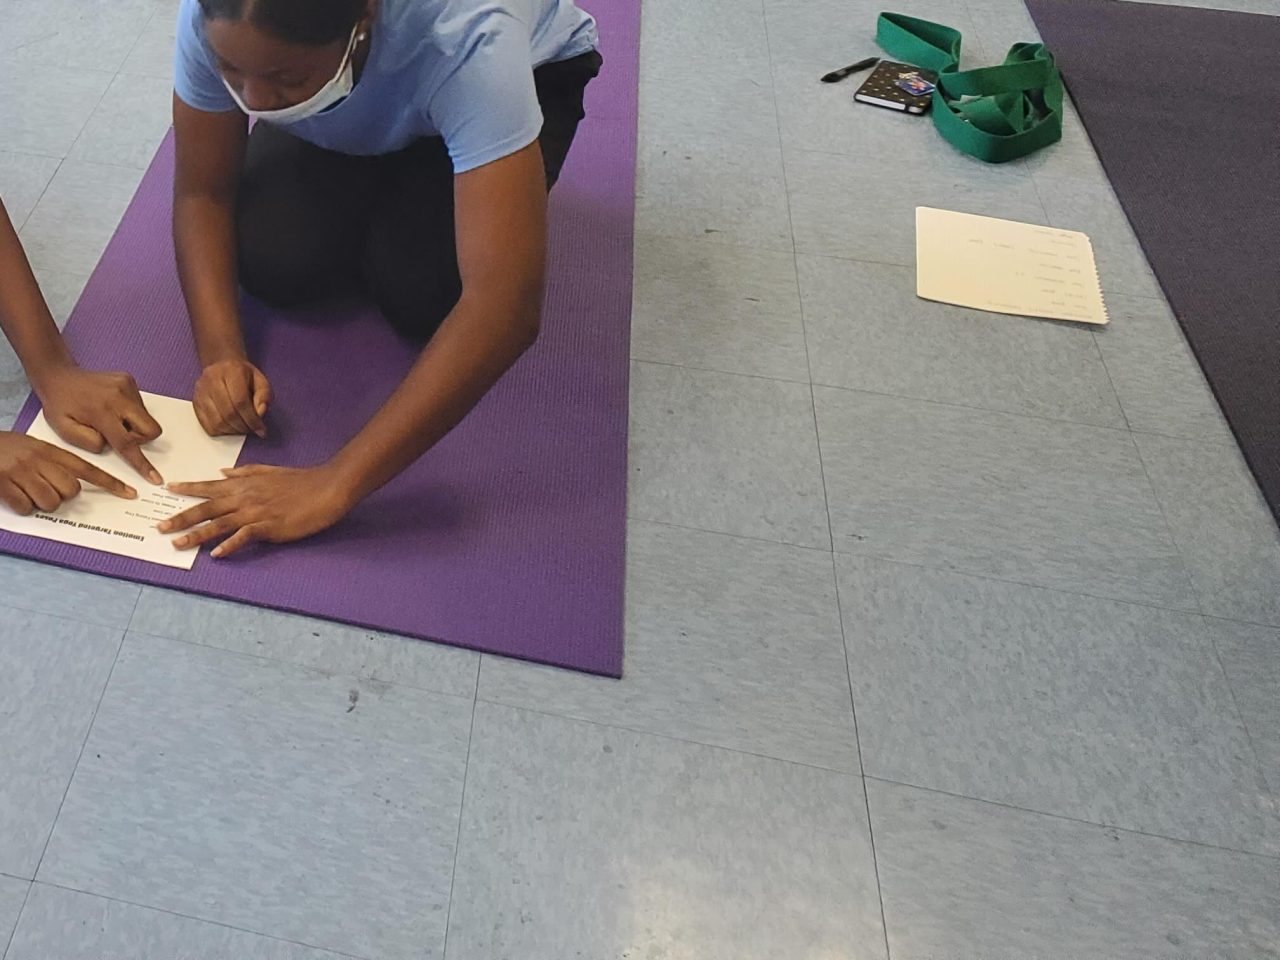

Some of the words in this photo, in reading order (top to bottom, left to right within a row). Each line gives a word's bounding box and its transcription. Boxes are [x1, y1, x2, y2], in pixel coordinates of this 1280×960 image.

[35, 513, 58, 524] Poses
[58, 518, 77, 528] Yoga
[78, 522, 112, 535] Targeted
[113, 529, 145, 542] Emotion
